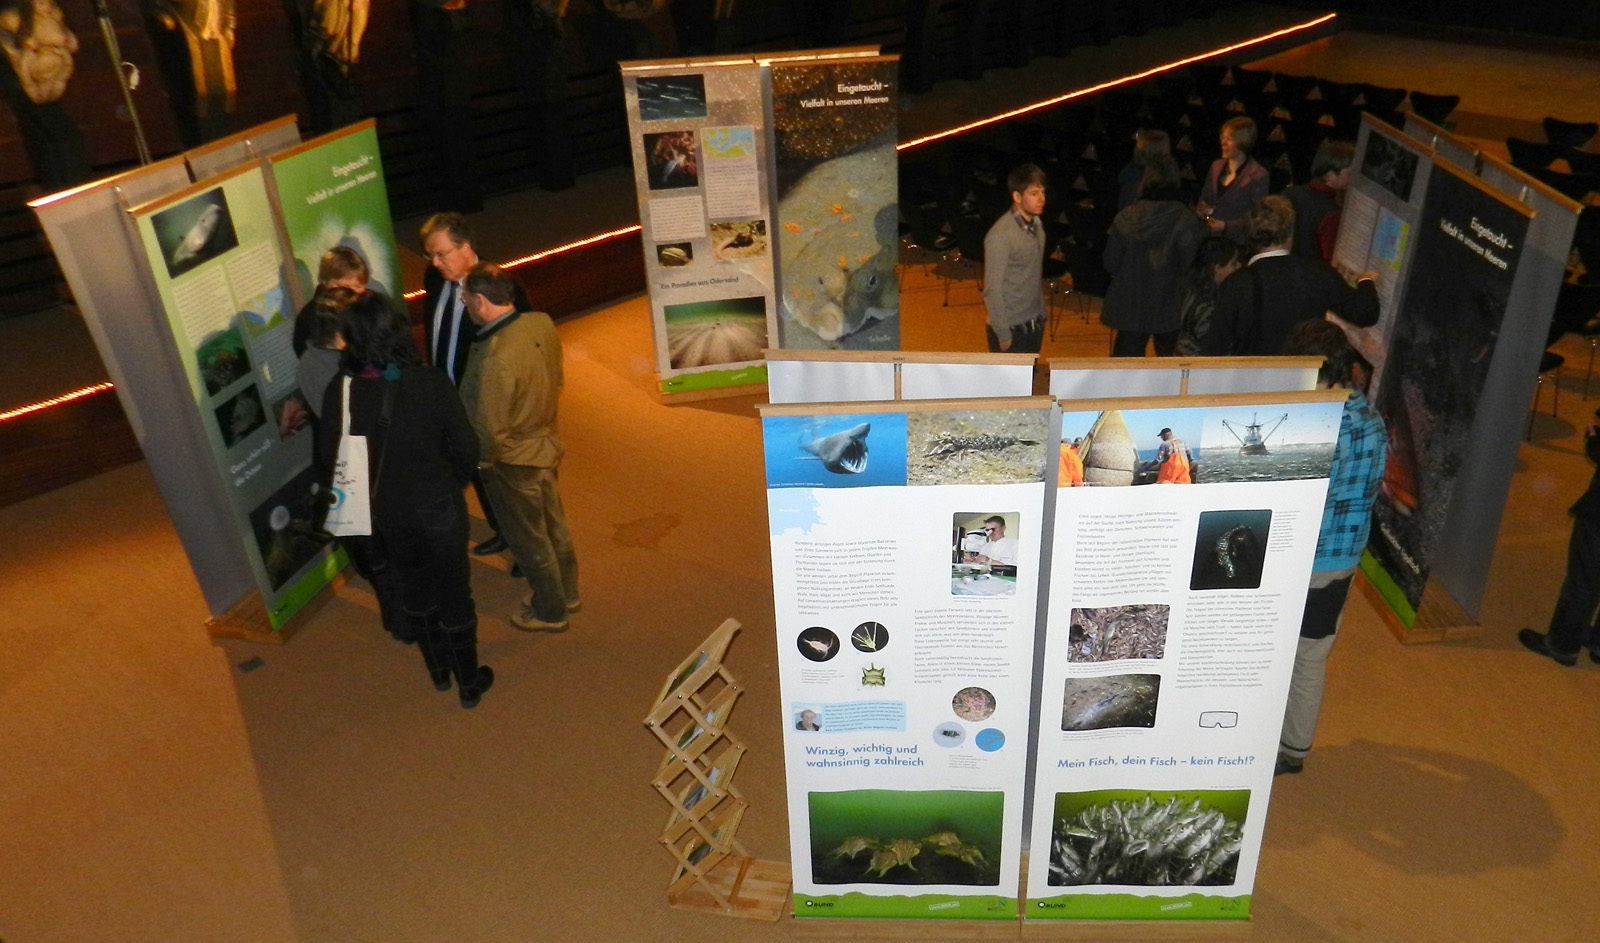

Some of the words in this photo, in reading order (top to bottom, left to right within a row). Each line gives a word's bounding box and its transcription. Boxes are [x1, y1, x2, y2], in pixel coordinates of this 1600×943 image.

[837, 81, 882, 94] Eingetaucht
[800, 98, 825, 107] Vielfalt
[827, 98, 833, 106] in
[835, 98, 862, 106] unseren
[864, 96, 888, 104] Meeren
[1471, 217, 1507, 248] Eingetaucht
[1484, 249, 1507, 270] Meeren
[806, 746, 849, 757] Winzig,
[853, 743, 892, 755] wichtig
[897, 744, 917, 754] und
[807, 757, 870, 767] wahnsinnig
[874, 756, 924, 766] zahlreich
[1058, 759, 1085, 768] Mein
[1089, 756, 1118, 766] Fisch,
[1122, 756, 1146, 765] dein
[1150, 757, 1177, 766] Fisch
[1190, 756, 1214, 765] kein
[1217, 756, 1254, 765] Fisch!?
